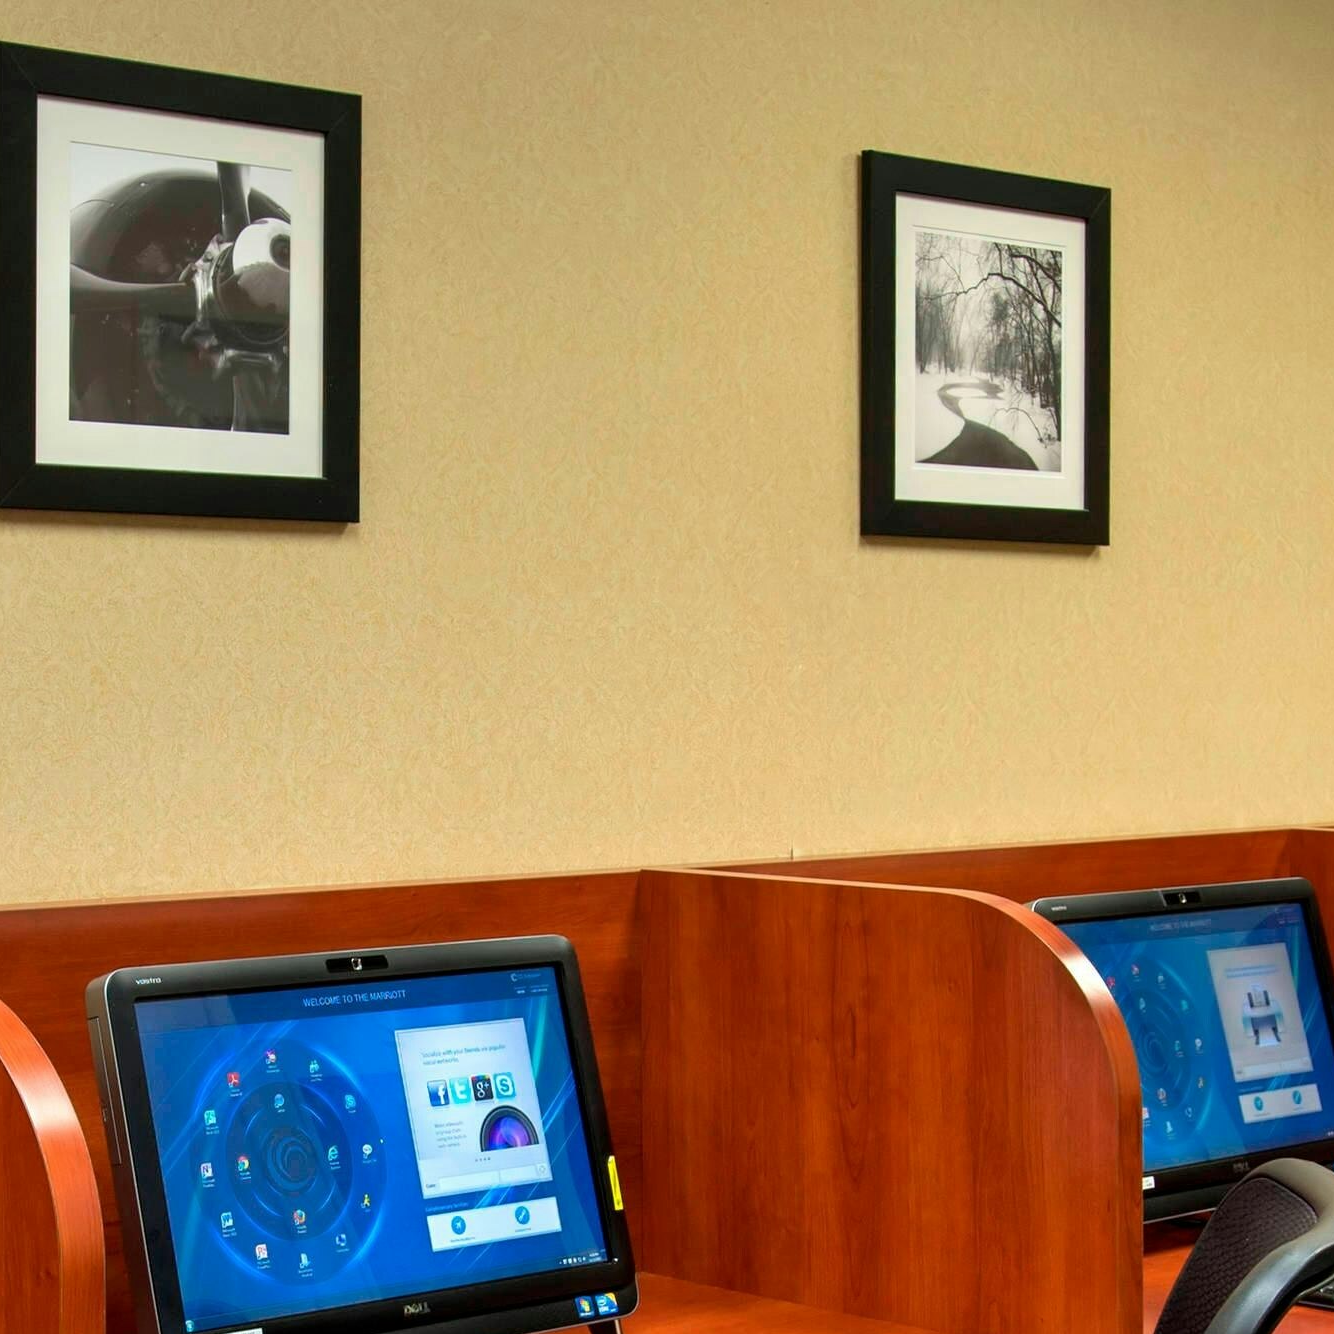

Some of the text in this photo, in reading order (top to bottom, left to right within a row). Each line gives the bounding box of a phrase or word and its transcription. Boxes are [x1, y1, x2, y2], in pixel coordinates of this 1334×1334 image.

[135, 977, 162, 986] vostro
[302, 989, 407, 1008] WELCOME TO THE MARRIOTT
